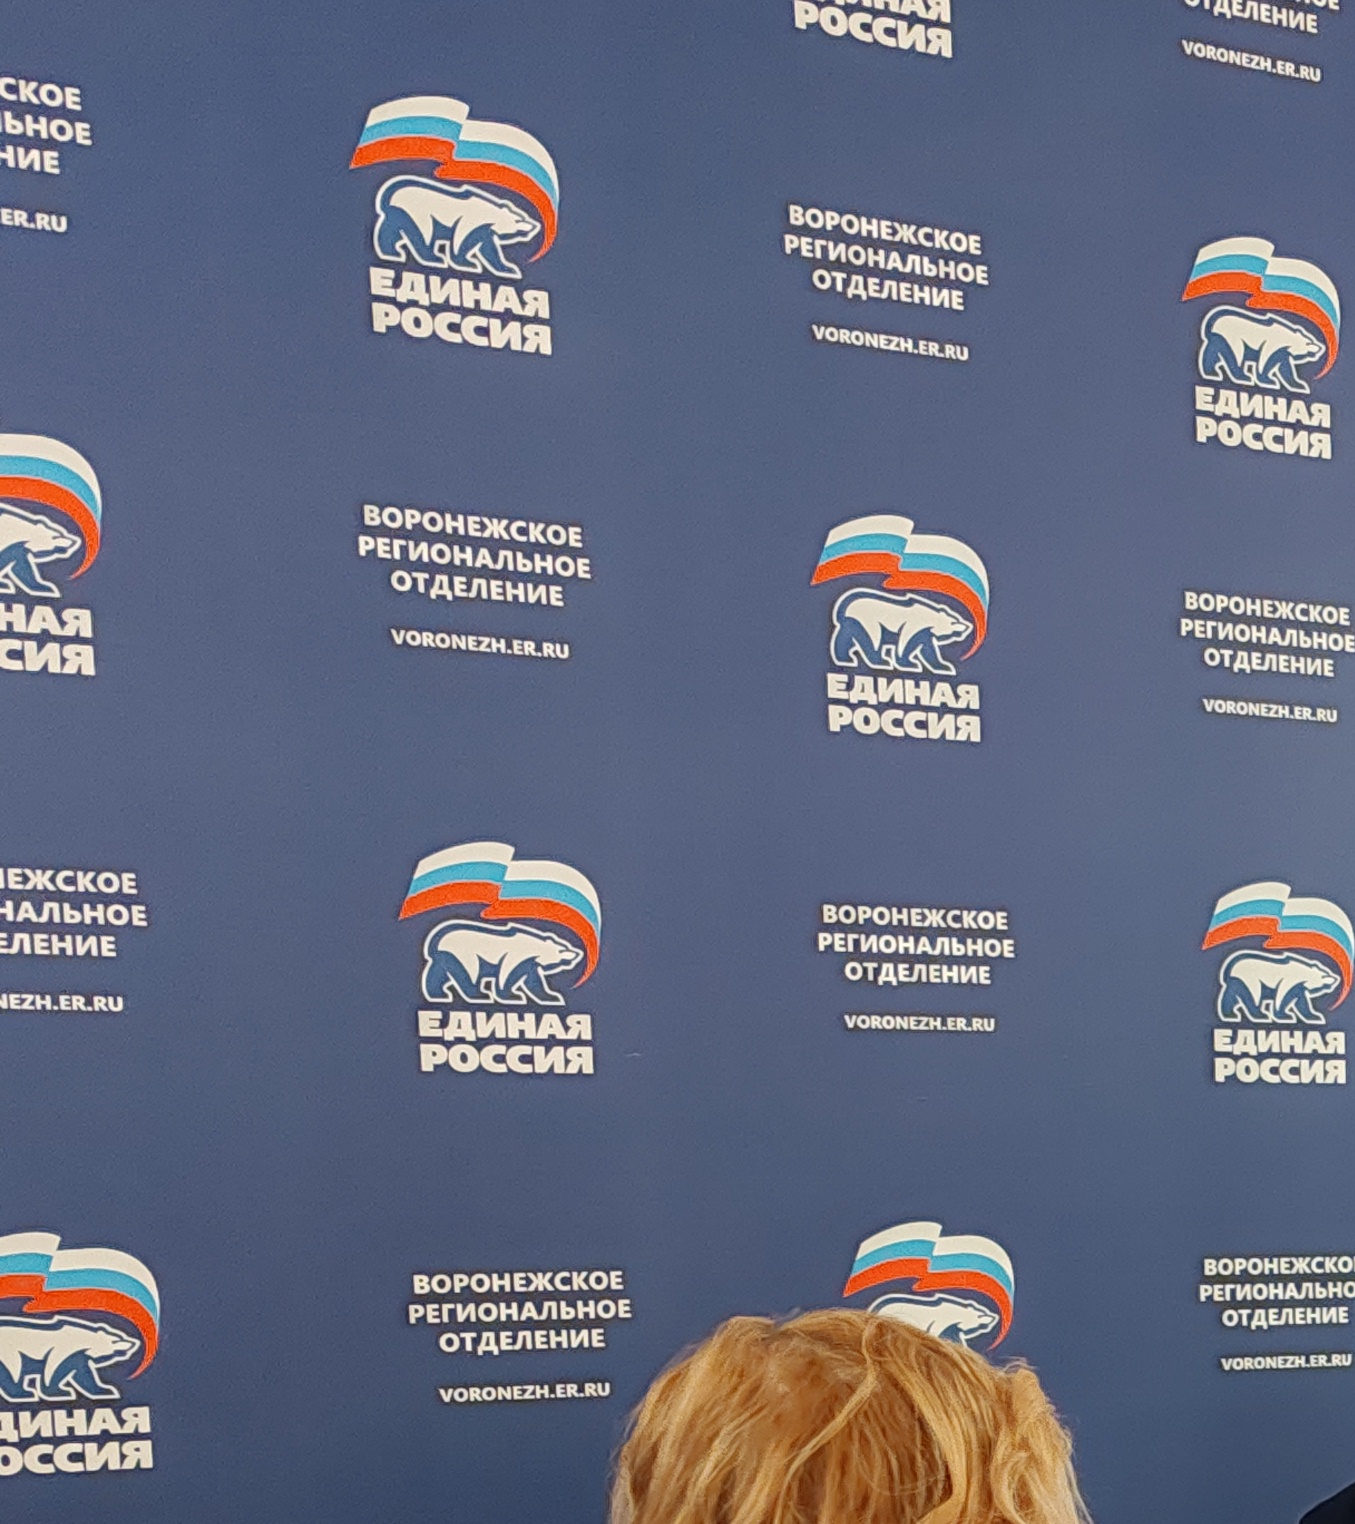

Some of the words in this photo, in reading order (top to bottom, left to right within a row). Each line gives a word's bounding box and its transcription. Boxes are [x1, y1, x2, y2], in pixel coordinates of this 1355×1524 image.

[794, 0, 953, 58] РОССИЯ
[1181, 39, 1321, 83] VORONEZH.ER.RU
[789, 204, 982, 256] ВОРОНЕЖСКОЕ
[783, 233, 989, 286] РЕГИОНАЛЬНОЕ
[369, 266, 550, 320] ЕДИНАЯ
[812, 268, 965, 311] ОТДЕЛЕНИЕ
[371, 301, 553, 356] РОССИЯ
[811, 324, 969, 361] VORONEZH.ER.RU
[1194, 385, 1331, 429] ЕДИНАЯ
[1195, 415, 1332, 460] РОССИЯ
[363, 504, 583, 548] ВОРОНЕЖСКОЕ
[358, 534, 592, 580] РЕГИОНАЛЬНОЕ
[390, 569, 565, 607] ОТДЕЛЕНИЕ
[0, 602, 94, 639] НАЯ
[1184, 591, 1351, 626] ВОРОНЕЖСКОЕ
[390, 628, 570, 659] VORONEZH.ER.RU
[1180, 618, 1355, 653] РЕГИОНАЛЬНОЕ
[0, 638, 96, 677] СИЯ
[1203, 647, 1335, 678] ОТДЕЛЕНИЕ
[826, 672, 980, 710] ЕДИНАЯ
[827, 704, 981, 743] РОССИЯ
[1202, 698, 1338, 723] VORONEZH.ER.RU
[0, 867, 138, 895] ЕЖСКОЕ
[822, 903, 1009, 931] ВОРОНЕЖСКОЕ
[0, 932, 117, 957] ЕЛЕНИЕ
[817, 932, 1015, 958] РЕГИОНАЛЬНОЕ
[844, 961, 992, 986] ОТДЕЛЕНИЕ
[417, 1010, 593, 1042] ЕДИНАЯ
[843, 1014, 996, 1032] VORONEZH.ER.RU
[419, 1043, 595, 1075] РОССИЯ
[1213, 1028, 1346, 1056] ЕДИНАЯ
[1214, 1057, 1347, 1085] РОССИЯ
[412, 1270, 624, 1295] ВОРОНЕЖСКОЕ
[408, 1298, 633, 1325] РЕГИОНАЛЬНОЕ
[1221, 1306, 1350, 1331] ОТДЕЛЕНИЕ
[438, 1328, 606, 1356] ОТДЕЛЕНИЕ
[1220, 1353, 1353, 1371] VORONEZH.ER.RU
[438, 1382, 611, 1403] VORONEZH.ER.RU
[0, 1405, 152, 1443] ДИНАЯ
[0, 1439, 154, 1476] ОССИЯ
